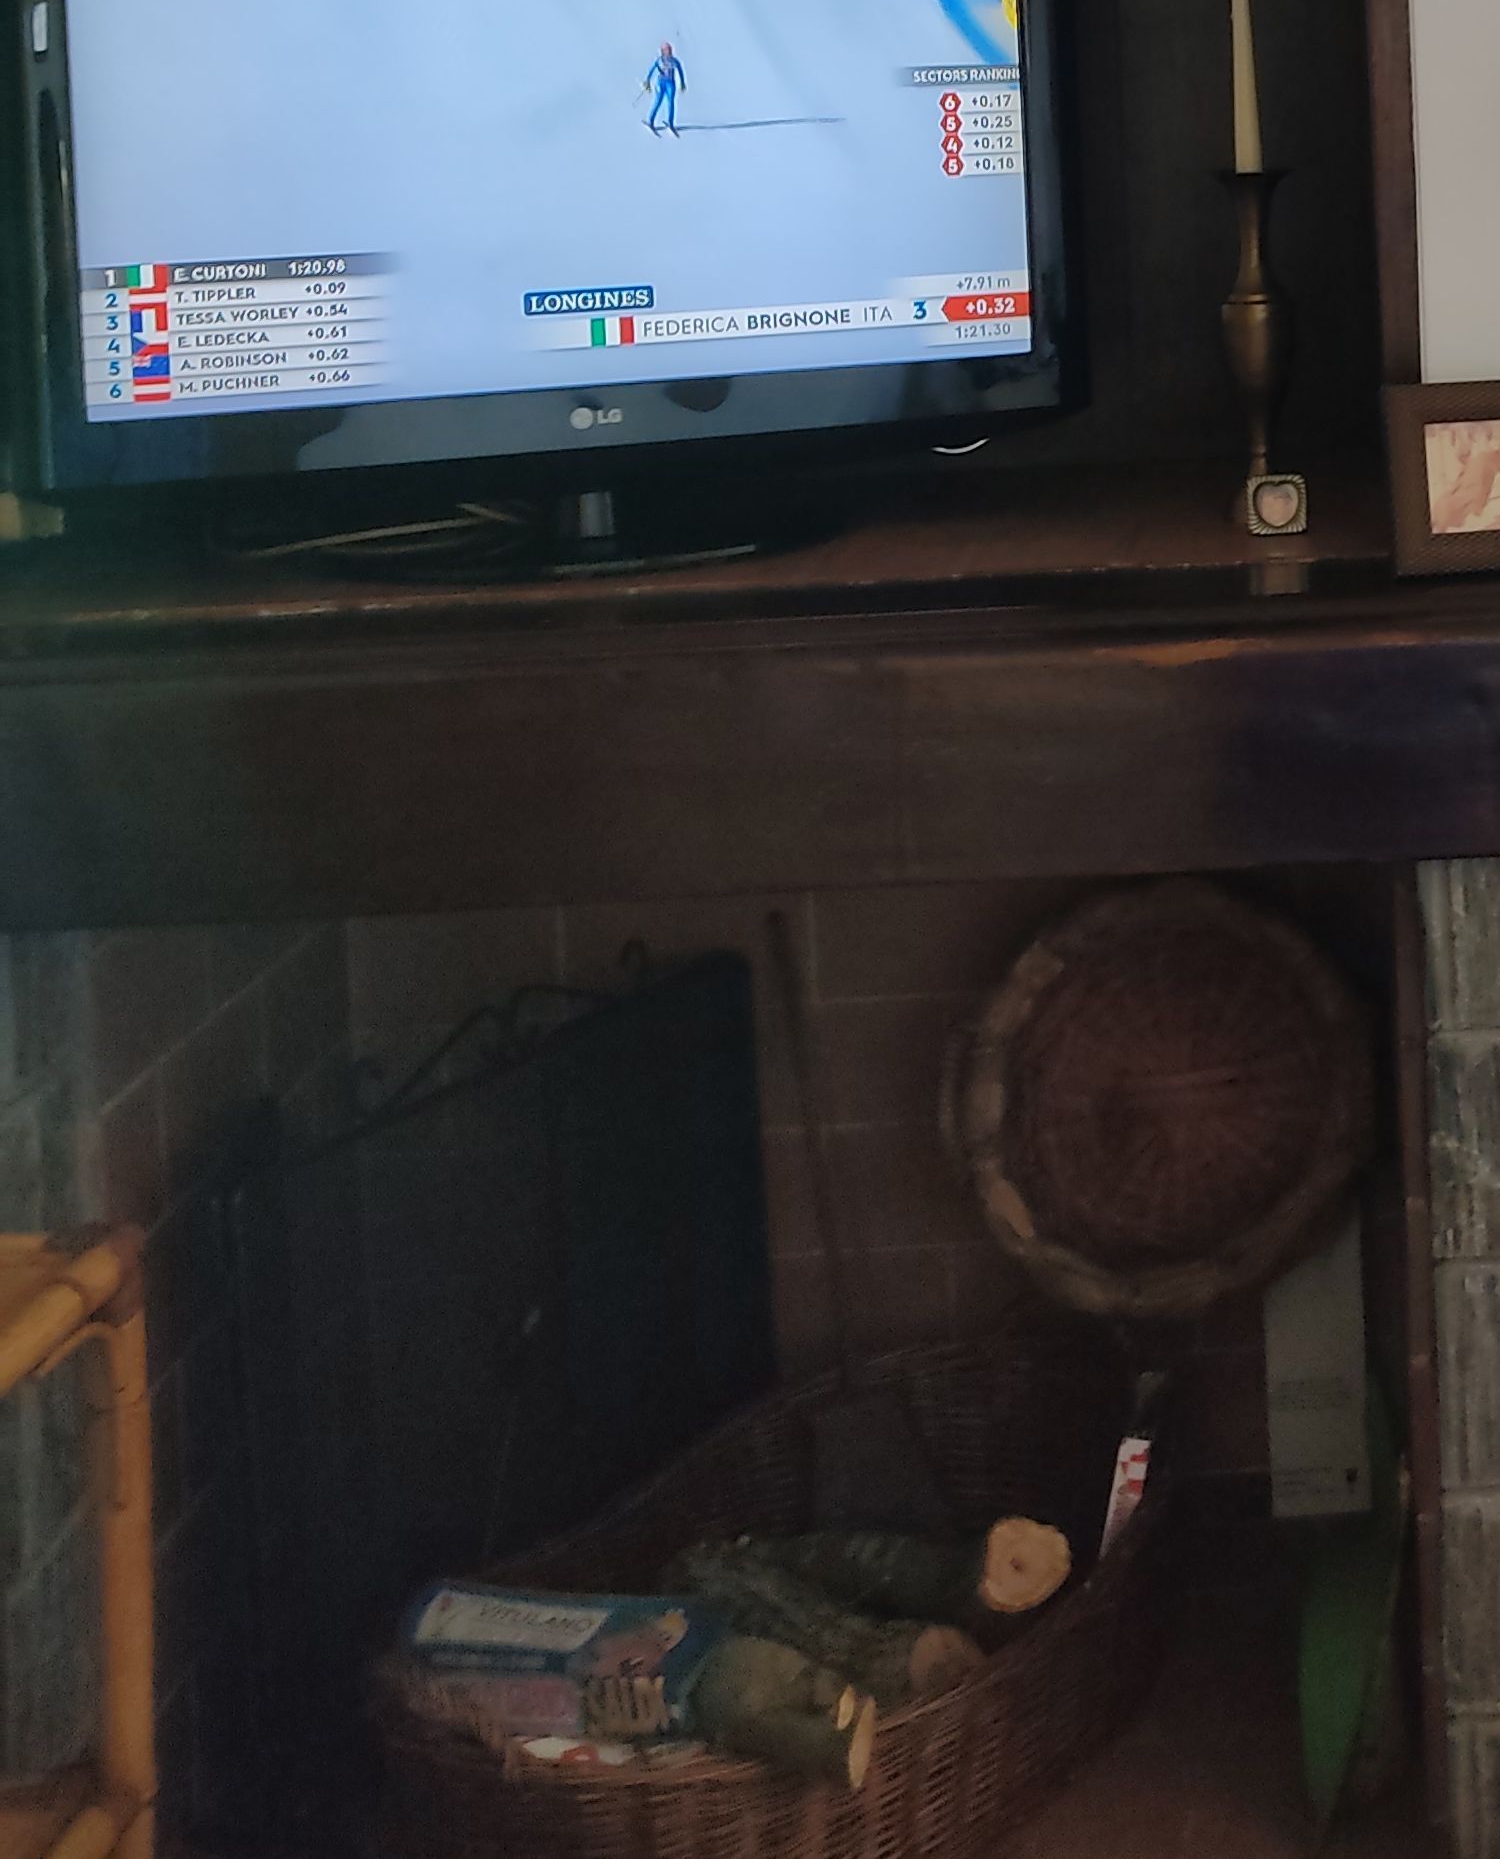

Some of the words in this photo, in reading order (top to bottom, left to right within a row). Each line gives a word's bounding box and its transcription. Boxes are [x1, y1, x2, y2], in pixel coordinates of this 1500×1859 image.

[913, 70, 968, 84] SECTORS
[970, 68, 1020, 82] RANKIN
[946, 96, 955, 110] 6
[973, 95, 1011, 107] +0.17
[946, 117, 955, 131] 5
[973, 116, 1013, 128] +0.25
[947, 137, 958, 152] 4
[974, 137, 1013, 150] +0.12
[948, 158, 958, 173] 5
[104, 269, 117, 286] 1
[192, 263, 266, 281] CURTONI
[288, 259, 346, 276] 1:20.98
[956, 276, 992, 290] +7.91
[998, 277, 1010, 288] m
[106, 293, 118, 309] 2
[192, 288, 256, 301] TIPPLER
[305, 282, 346, 295] +0.09
[530, 289, 650, 313] LONGINES
[106, 315, 118, 331] 3
[176, 311, 226, 325] TESSA
[231, 307, 299, 322] WORLEY
[306, 303, 348, 317] +0.54
[643, 316, 738, 337] FEDERICA
[748, 309, 850, 330] BRIGNONE
[864, 307, 892, 322] ITA
[913, 301, 928, 320] 3
[966, 297, 1016, 315] +0.32
[108, 337, 120, 353] 4
[196, 332, 270, 347] LEDECKA
[308, 325, 348, 340] +0.61
[956, 323, 1011, 339] 1:21.30
[108, 361, 120, 375] 5
[201, 352, 286, 368] ROBINSON
[308, 349, 349, 361] +0.62
[110, 383, 121, 398] 6
[202, 375, 279, 391] PUCHNER
[309, 371, 350, 384] +0.66
[597, 408, 623, 425] LG
